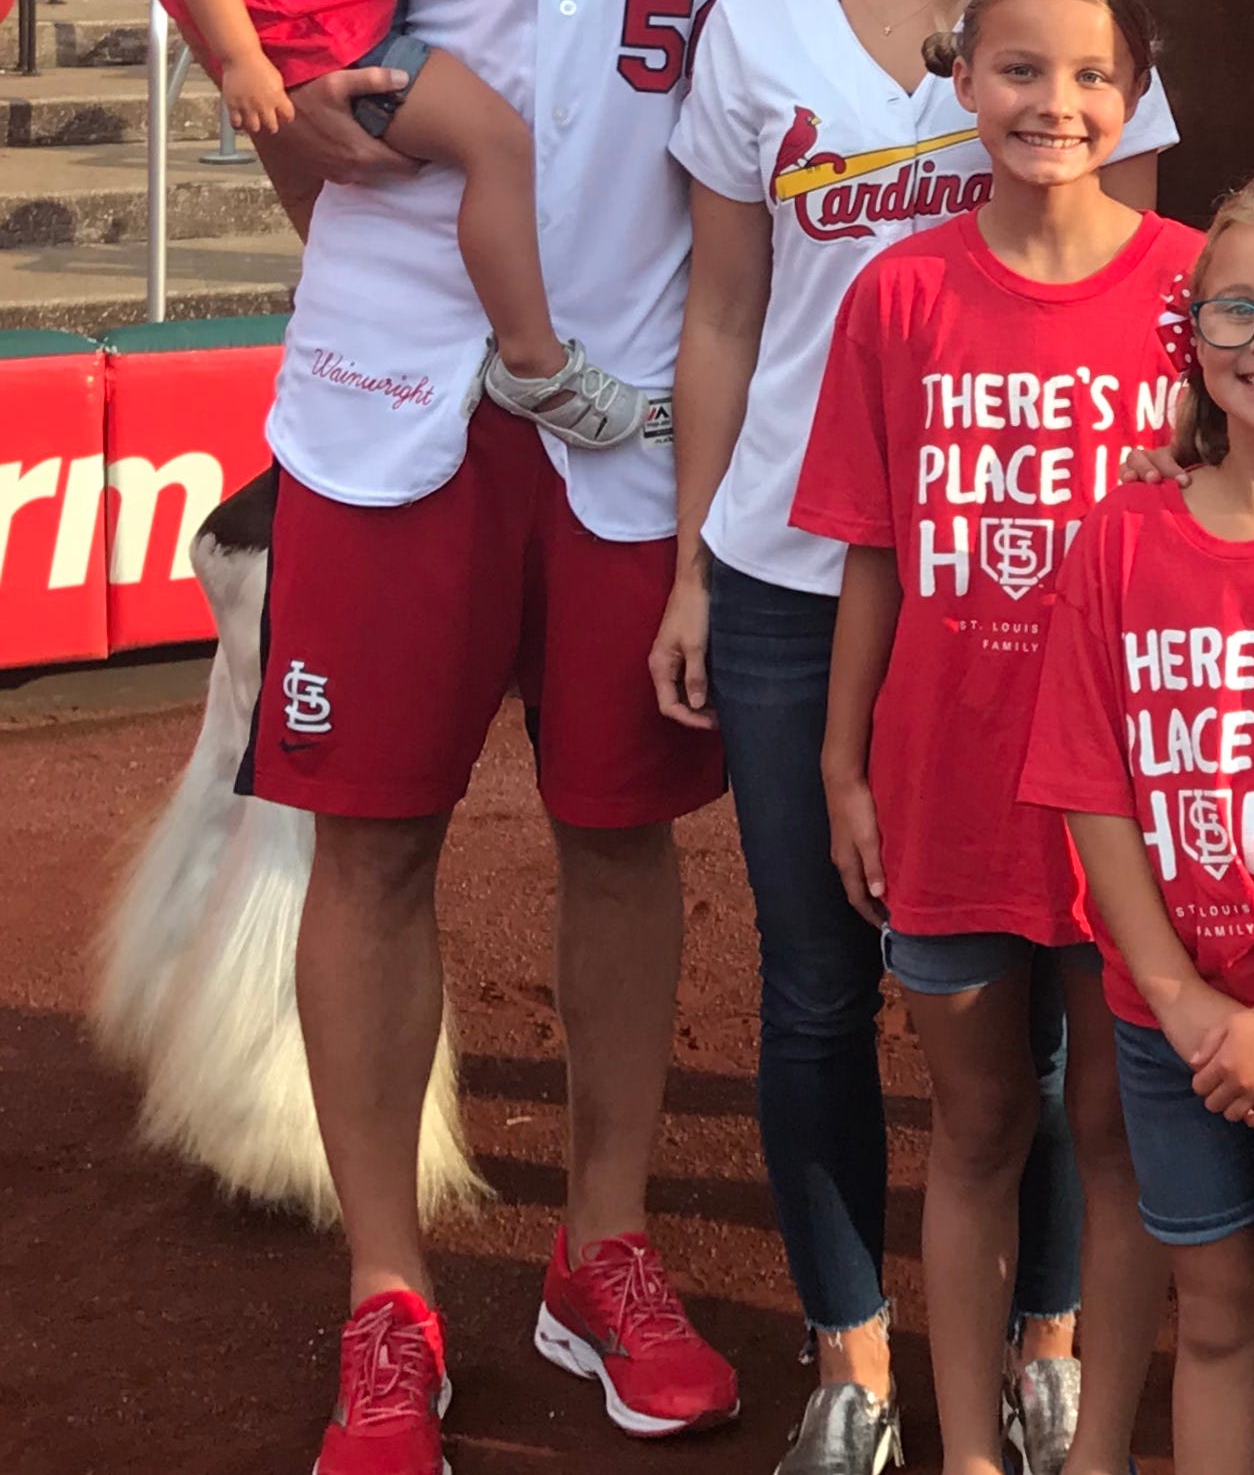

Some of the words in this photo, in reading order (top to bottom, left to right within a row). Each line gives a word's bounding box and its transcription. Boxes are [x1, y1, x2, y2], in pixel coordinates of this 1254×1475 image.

[311, 347, 435, 411] Wainwright
[921, 366, 1120, 431] THERE'S
[918, 444, 1074, 505] PLACE
[992, 622, 1039, 634] LOUIS
[982, 639, 1039, 652] FAMILY
[1199, 904, 1250, 918] LOUIS
[1197, 923, 1254, 937] FAMILY
